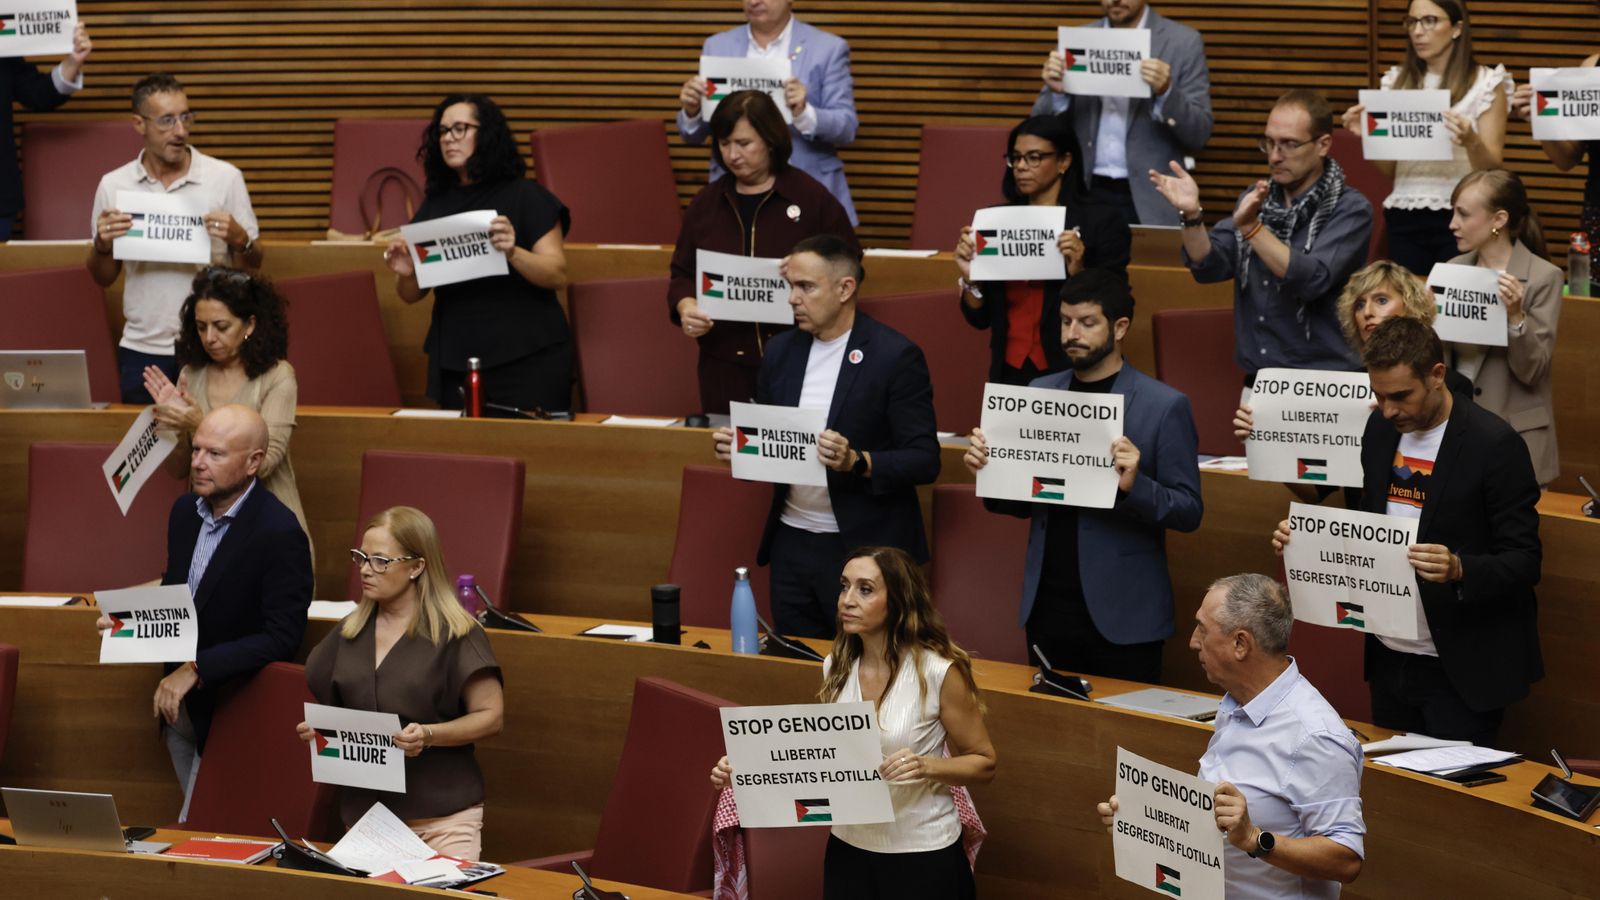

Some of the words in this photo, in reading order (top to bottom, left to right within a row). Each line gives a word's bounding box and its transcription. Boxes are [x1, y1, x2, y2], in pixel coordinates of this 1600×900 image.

[18, 10, 71, 22] PALESTINA
[19, 22, 62, 35] LLIURE
[1089, 49, 1142, 61] PALESTINA
[1089, 62, 1132, 75] LLIURE
[730, 77, 785, 89] PALESTINA
[1390, 111, 1443, 123] PALESTINA
[1562, 103, 1600, 117] LLIUR
[1391, 125, 1433, 138] LLIURE
[148, 214, 204, 227] PALESTINA
[147, 227, 193, 241] LLIURE
[439, 231, 491, 247] PALESTIN
[1000, 229, 1055, 241] PALESTINA
[443, 241, 489, 261] LLIURE
[1001, 243, 1045, 257] LLIURE
[727, 275, 786, 290] PALESTINA
[727, 288, 774, 303] LLIURE
[1446, 287, 1499, 306] PALESTINA
[1444, 302, 1488, 321] LLIURE
[1254, 380, 1290, 395] STOP
[1293, 381, 1373, 400] GENOCIDI
[987, 395, 1027, 413] STOP
[1031, 399, 1117, 421] GENOCIDI
[1281, 410, 1339, 424] LLIBERTAT
[127, 417, 159, 460] PALESTIN
[761, 428, 817, 446] PALESTINA
[1019, 427, 1081, 443] LLIBERTAT
[1249, 430, 1320, 445] SEGRESTATS
[1322, 434, 1361, 447] FLOTIL
[129, 430, 159, 474] LLIURE
[761, 442, 806, 461] LLIURE
[984, 446, 1059, 464] SEGRESTATS
[1390, 483, 1412, 498] lvem
[1289, 515, 1326, 534] STOP
[1329, 521, 1410, 546] GENOCIDI
[1319, 550, 1376, 569] LLIBERTAT
[1289, 568, 1357, 589] SEGRESTATS
[1359, 579, 1412, 597] FLOTILLA
[134, 607, 190, 621] PALESTINA
[136, 622, 180, 639] LLIURE
[727, 719, 774, 735] STOP
[777, 714, 871, 734] GENOCIDI
[342, 744, 387, 765] LLIURE
[770, 747, 836, 761] LLIBERTAT
[735, 771, 818, 786] SEGRESTATS
[820, 769, 882, 783] FLOTILLA
[1119, 762, 1148, 787] STOP
[1151, 775, 1214, 811] GENOCID
[1144, 805, 1190, 834] LLIBERTAT
[1117, 820, 1175, 853] SEGRESTATS
[1176, 842, 1221, 870] FLOTILLA
